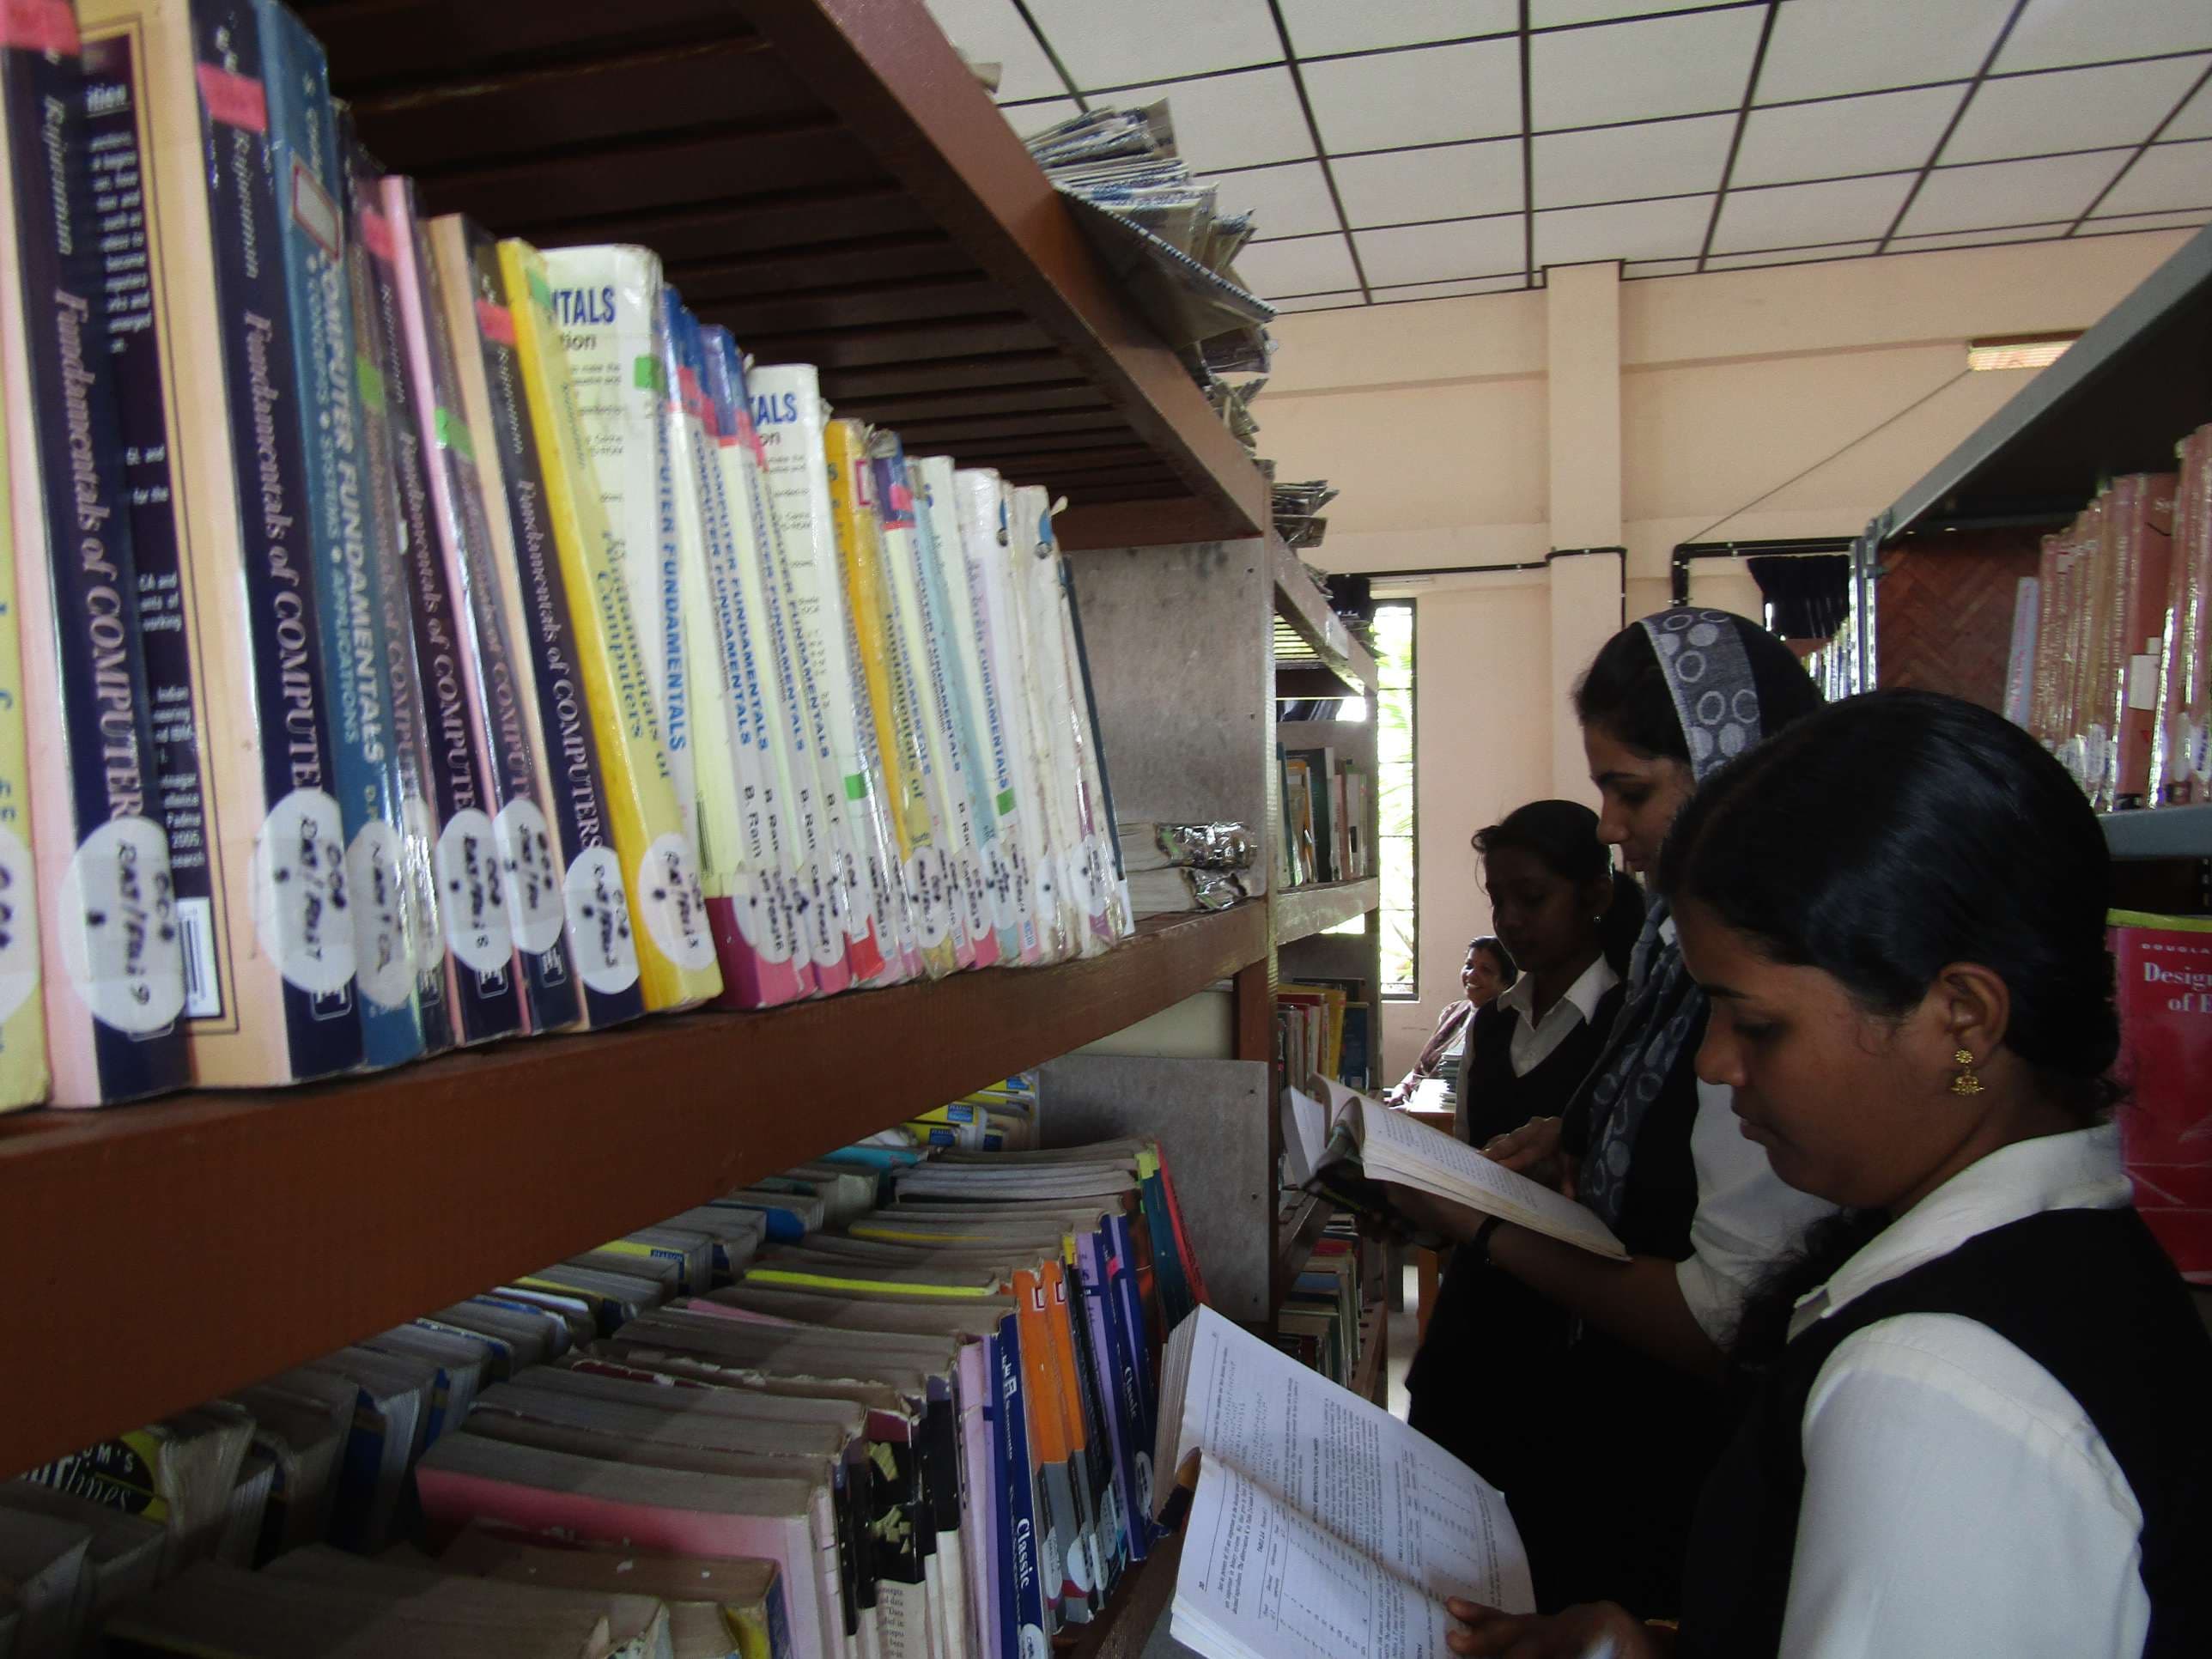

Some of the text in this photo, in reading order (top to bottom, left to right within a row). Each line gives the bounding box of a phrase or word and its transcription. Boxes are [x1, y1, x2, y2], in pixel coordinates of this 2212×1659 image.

[554, 285, 616, 325] TALS
[55, 288, 110, 532] Fundamentals
[244, 309, 294, 540] Fundamentals
[82, 539, 118, 582] of
[268, 546, 301, 586] of
[337, 460, 385, 763] FUNDAMENTALS
[398, 432, 443, 612] Fundamentals
[426, 617, 448, 647] of
[331, 568, 359, 744] APPLICATIONS
[516, 480, 603, 849] Fundamentals of COMPUTERS
[598, 570, 644, 738] Computers
[662, 542, 686, 752] FUNDAMENTALS
[714, 564, 751, 744] FUNDAMENTALS
[731, 577, 769, 750] FUNDAMENTALS
[769, 585, 805, 751] FUNDAMENTALS
[788, 601, 830, 758] FUNDAMENTALS
[931, 637, 961, 772] FUNDAMENTALS
[979, 648, 1010, 788] FUNDAMENTALS
[2167, 993, 2195, 1012] of
[1017, 1516, 1030, 1589] Classic
